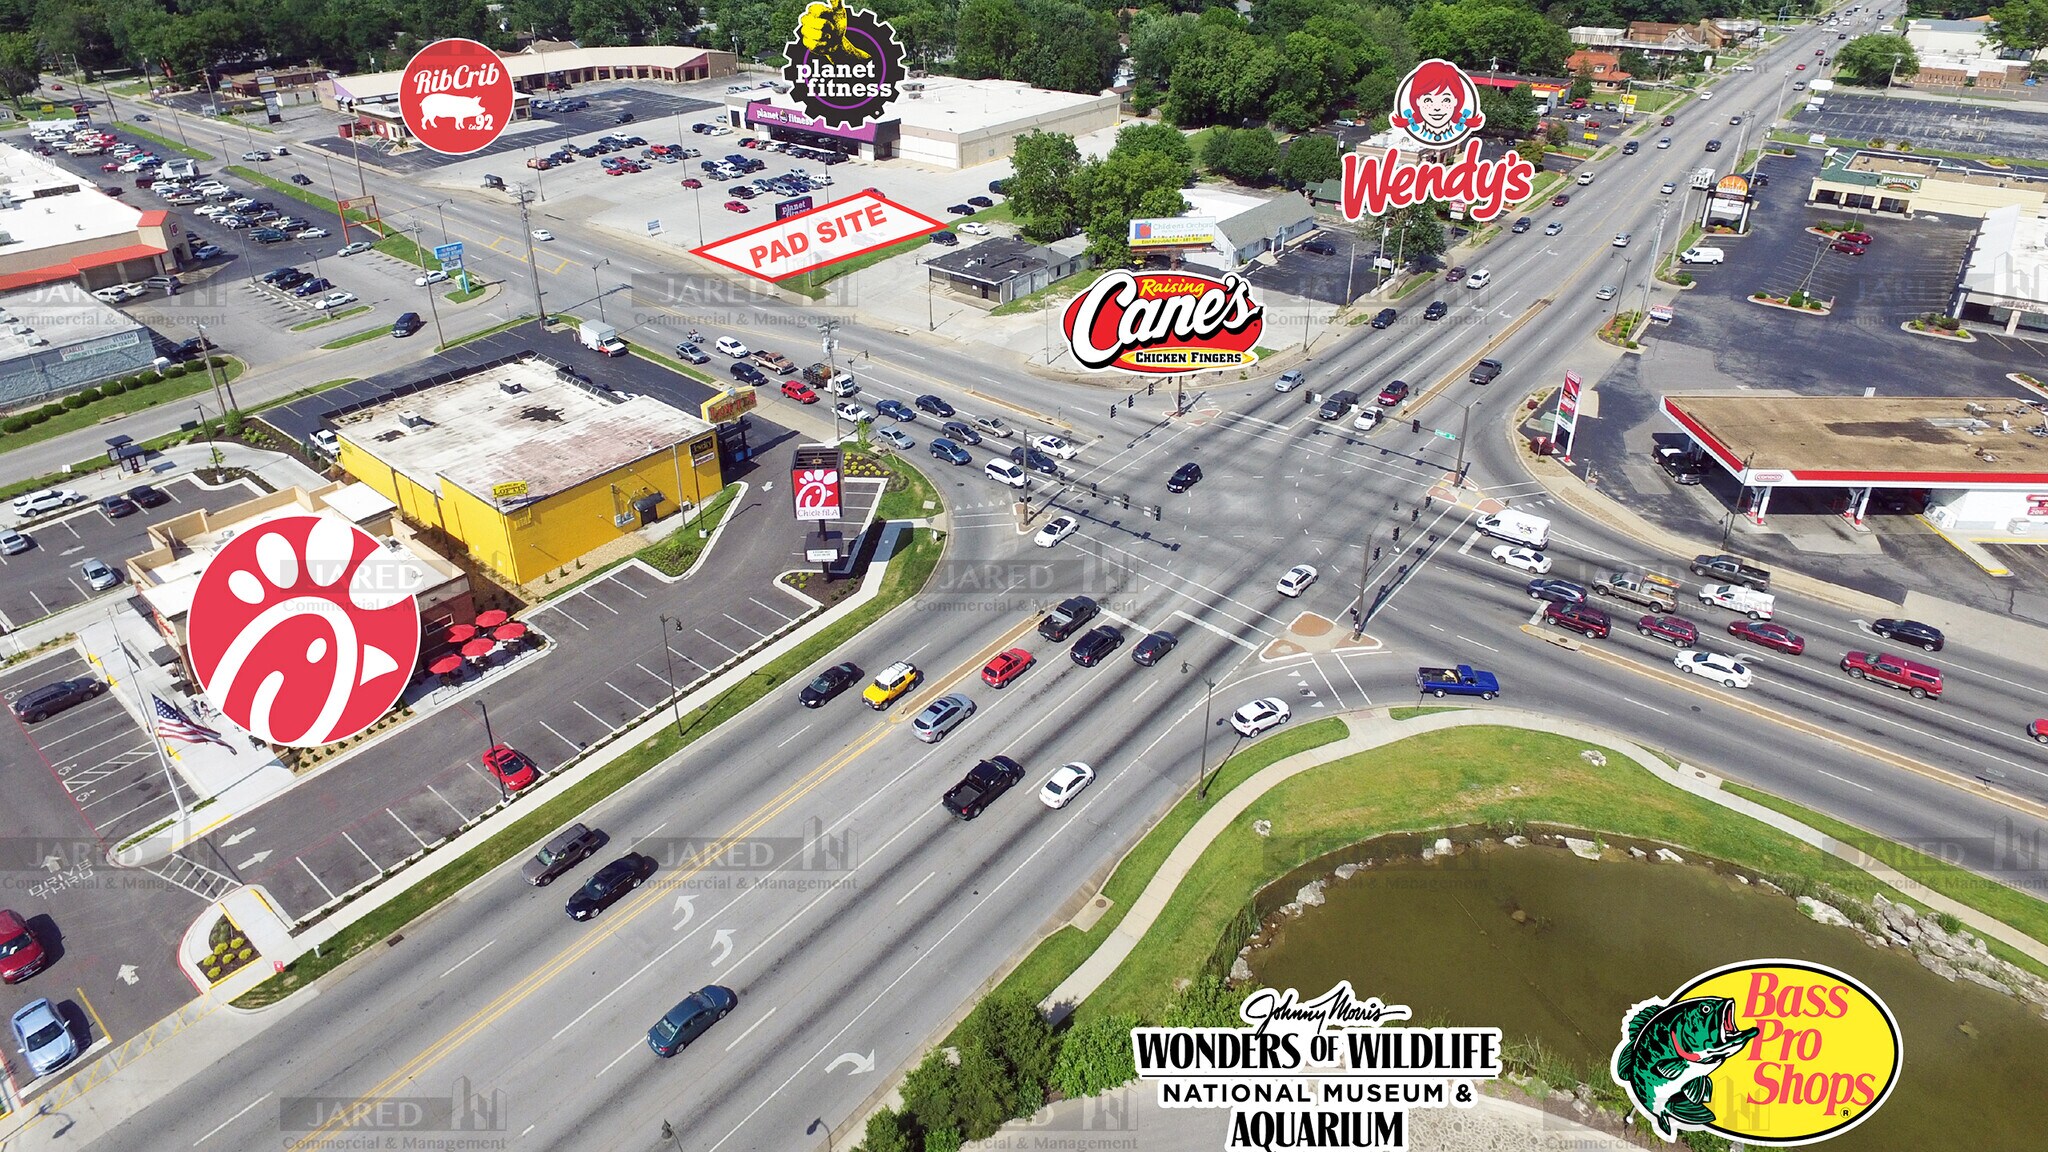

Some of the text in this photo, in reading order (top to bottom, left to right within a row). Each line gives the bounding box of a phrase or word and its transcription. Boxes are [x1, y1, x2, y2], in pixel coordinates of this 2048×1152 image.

[781, 200, 806, 215] planet
[29, 859, 93, 896] DRIVE
[36, 868, 94, 900] THRU
